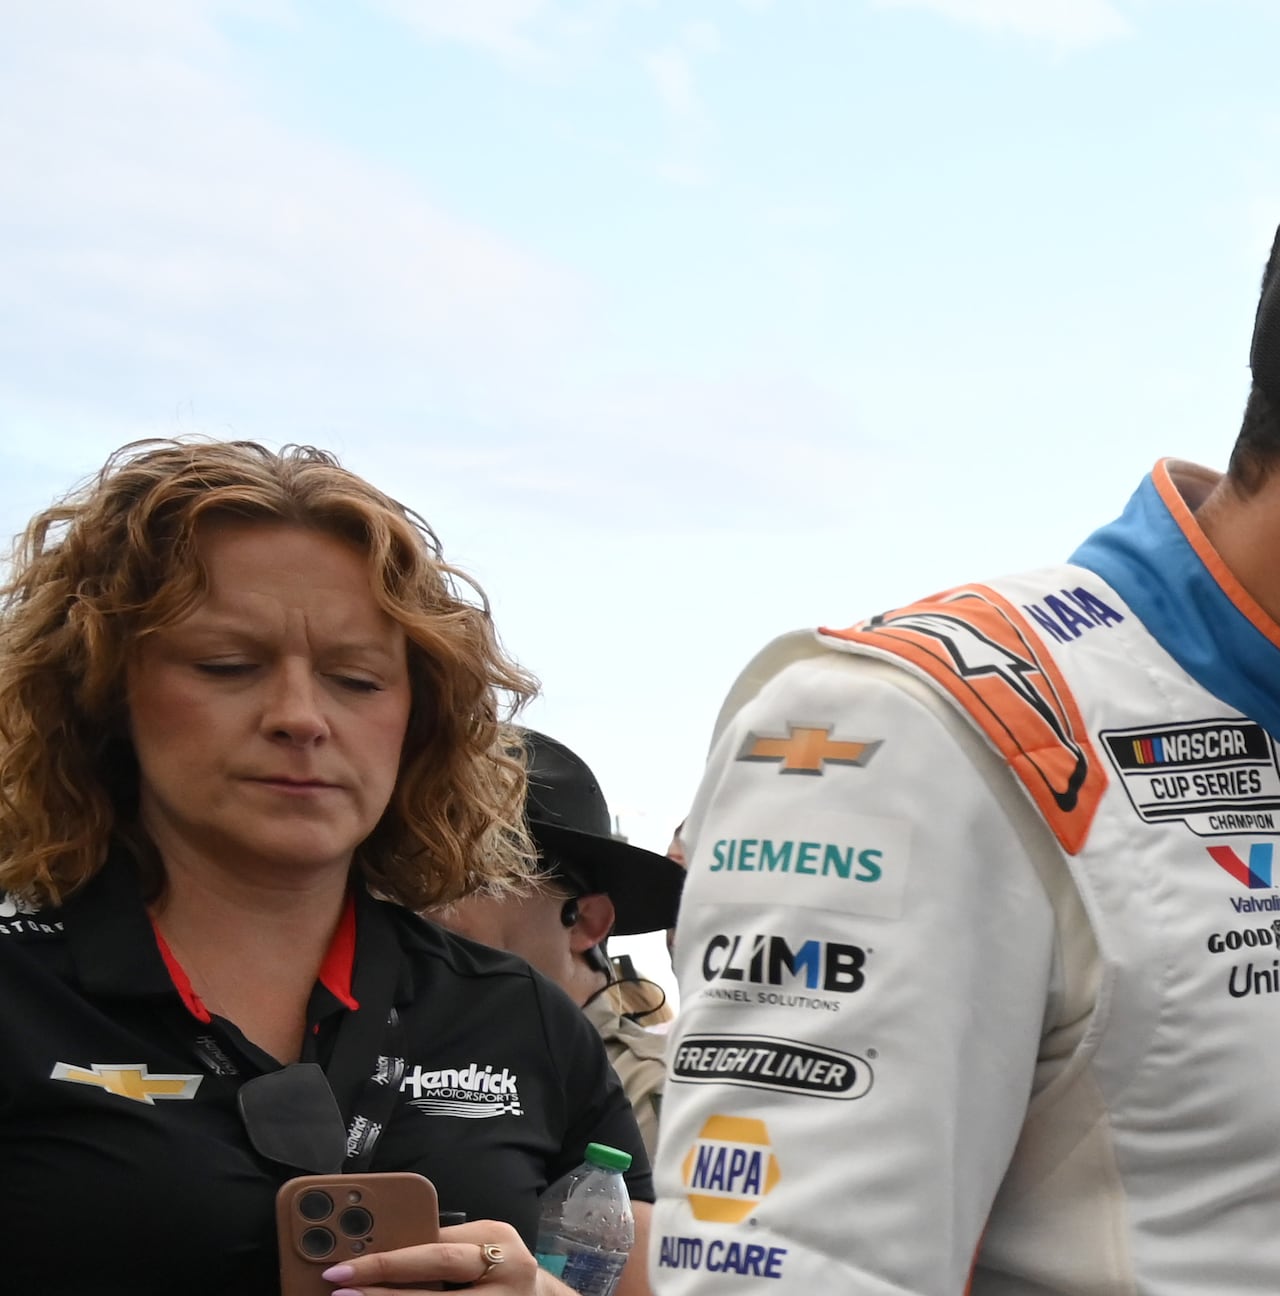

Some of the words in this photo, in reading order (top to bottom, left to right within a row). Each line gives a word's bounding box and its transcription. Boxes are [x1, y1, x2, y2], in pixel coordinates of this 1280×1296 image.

[1161, 729, 1248, 762] NASCAR
[1150, 776, 1190, 800] CUP
[1192, 769, 1262, 798] SERIES
[1208, 813, 1274, 831] CHAMPION
[709, 838, 883, 883] SIEMENS
[702, 934, 867, 994] CLIMB
[757, 991, 840, 1013] SOLUTIONS
[400, 1063, 517, 1098] Hendrick
[675, 1046, 848, 1088] FREIGHTLINER
[426, 1087, 519, 1102] MOTORSPORTS
[691, 1144, 763, 1195] NAPA
[658, 1235, 702, 1270] AUTO
[706, 1239, 788, 1279] CARE
